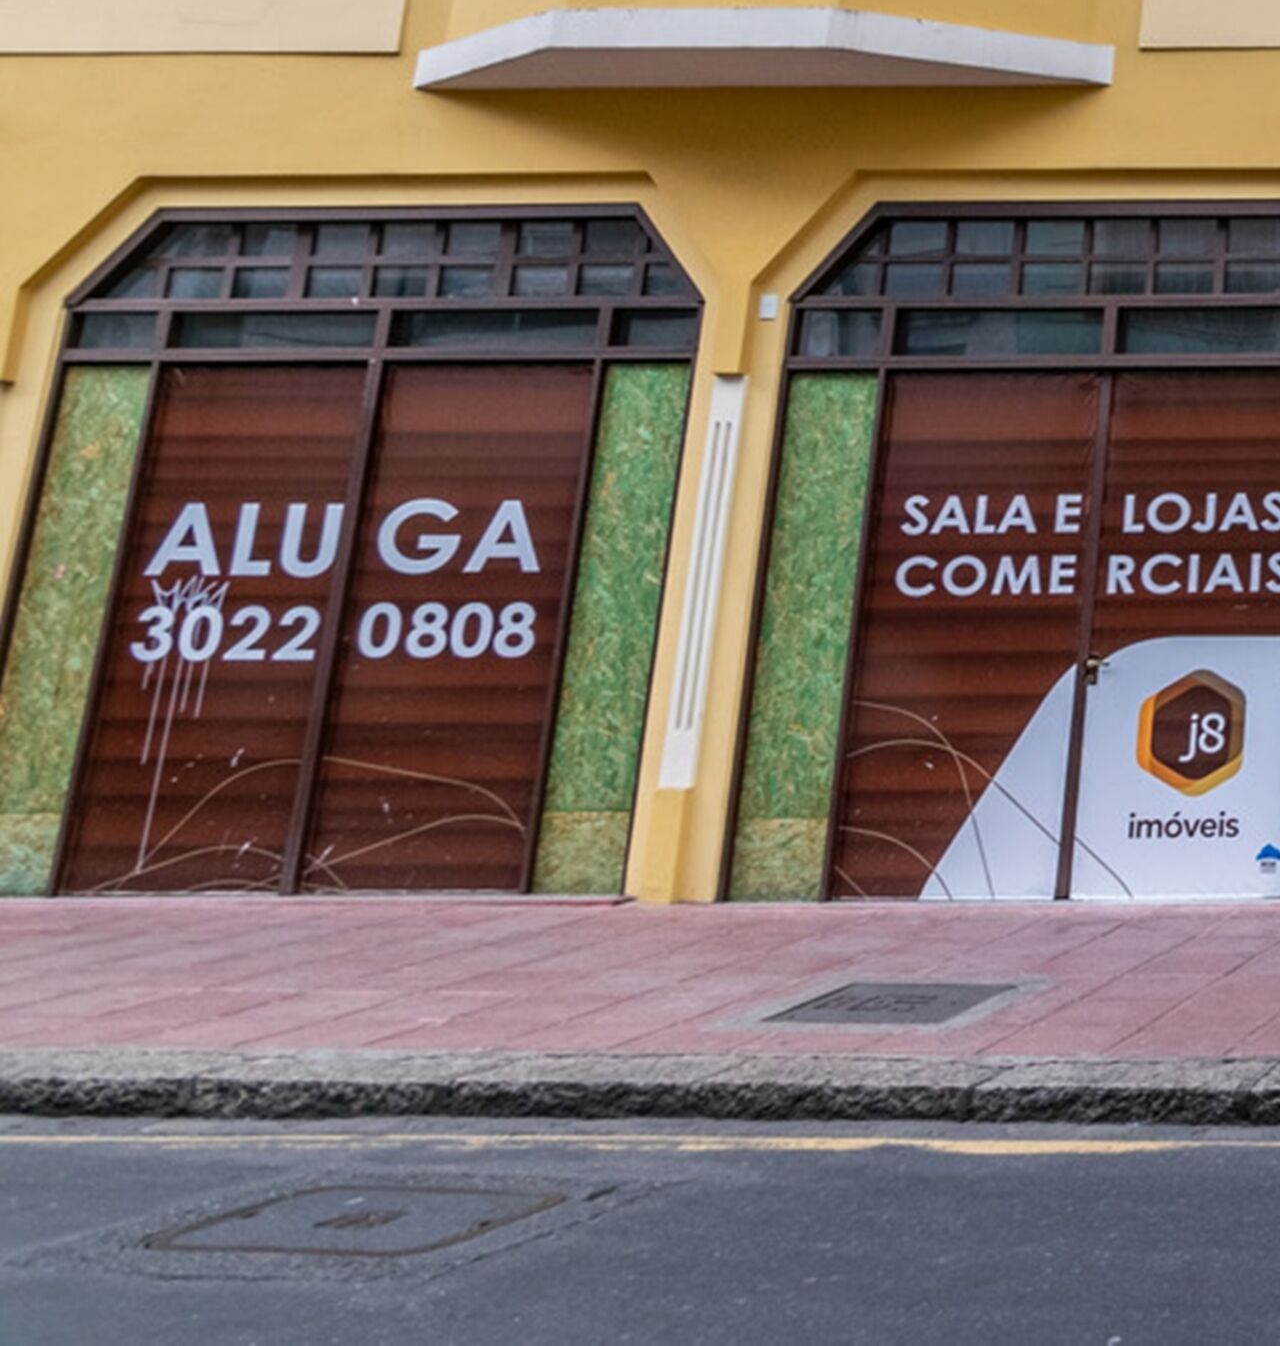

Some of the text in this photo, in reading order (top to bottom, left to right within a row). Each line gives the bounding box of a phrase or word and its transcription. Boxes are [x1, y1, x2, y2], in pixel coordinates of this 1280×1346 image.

[900, 494, 1037, 536] SALA
[1054, 494, 1083, 534] E
[130, 601, 536, 662] 3022 0808
[1178, 712, 1226, 763] j8
[1128, 811, 1240, 840] imóveis
